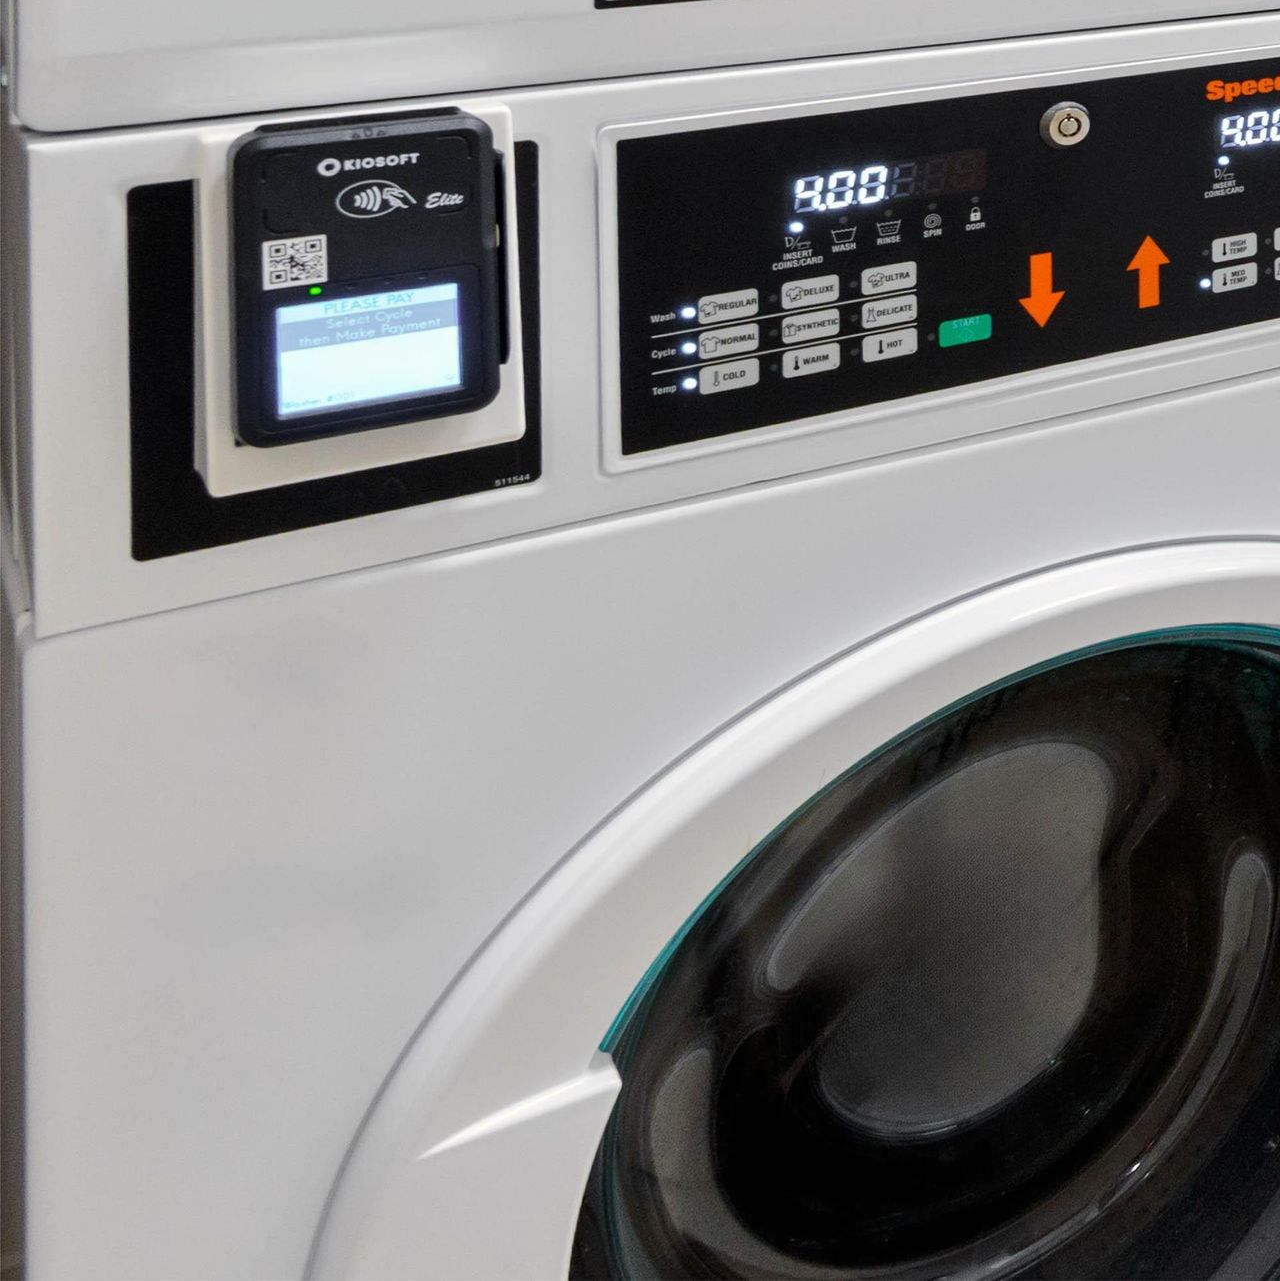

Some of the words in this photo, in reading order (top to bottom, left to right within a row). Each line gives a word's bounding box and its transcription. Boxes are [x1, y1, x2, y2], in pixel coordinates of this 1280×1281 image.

[343, 152, 420, 171] KIOSOFT
[425, 192, 465, 209] Elite
[965, 222, 986, 231] DOOR
[923, 228, 943, 238] SPIN
[877, 235, 901, 246] RINSE
[1230, 239, 1247, 248] HIGH
[831, 242, 857, 253] WASH
[1230, 246, 1247, 255] TEMP
[783, 249, 813, 260] INSERT
[772, 256, 824, 271] COINS/CARD
[885, 272, 911, 283] ULTRA
[1231, 270, 1245, 278] MED
[1229, 276, 1247, 285] TEMP
[803, 285, 835, 297] DELUXE
[323, 295, 380, 315] PLEASE
[387, 292, 416, 306] PAY
[718, 298, 757, 311] REGULAR
[876, 304, 913, 317] DELICATE
[327, 314, 370, 330] Select
[375, 308, 413, 325] Cycle
[650, 312, 676, 324] Wash
[952, 317, 980, 329] START
[797, 318, 839, 332] SYNTHETIC
[299, 334, 330, 347] then
[336, 327, 376, 341] Make
[381, 318, 441, 336] Payment
[720, 333, 756, 346] NORMAL
[886, 339, 903, 349] HOT
[651, 348, 676, 359] Cycle
[802, 354, 830, 365] WARM
[723, 370, 746, 381] COLD
[652, 385, 677, 397] Temp
